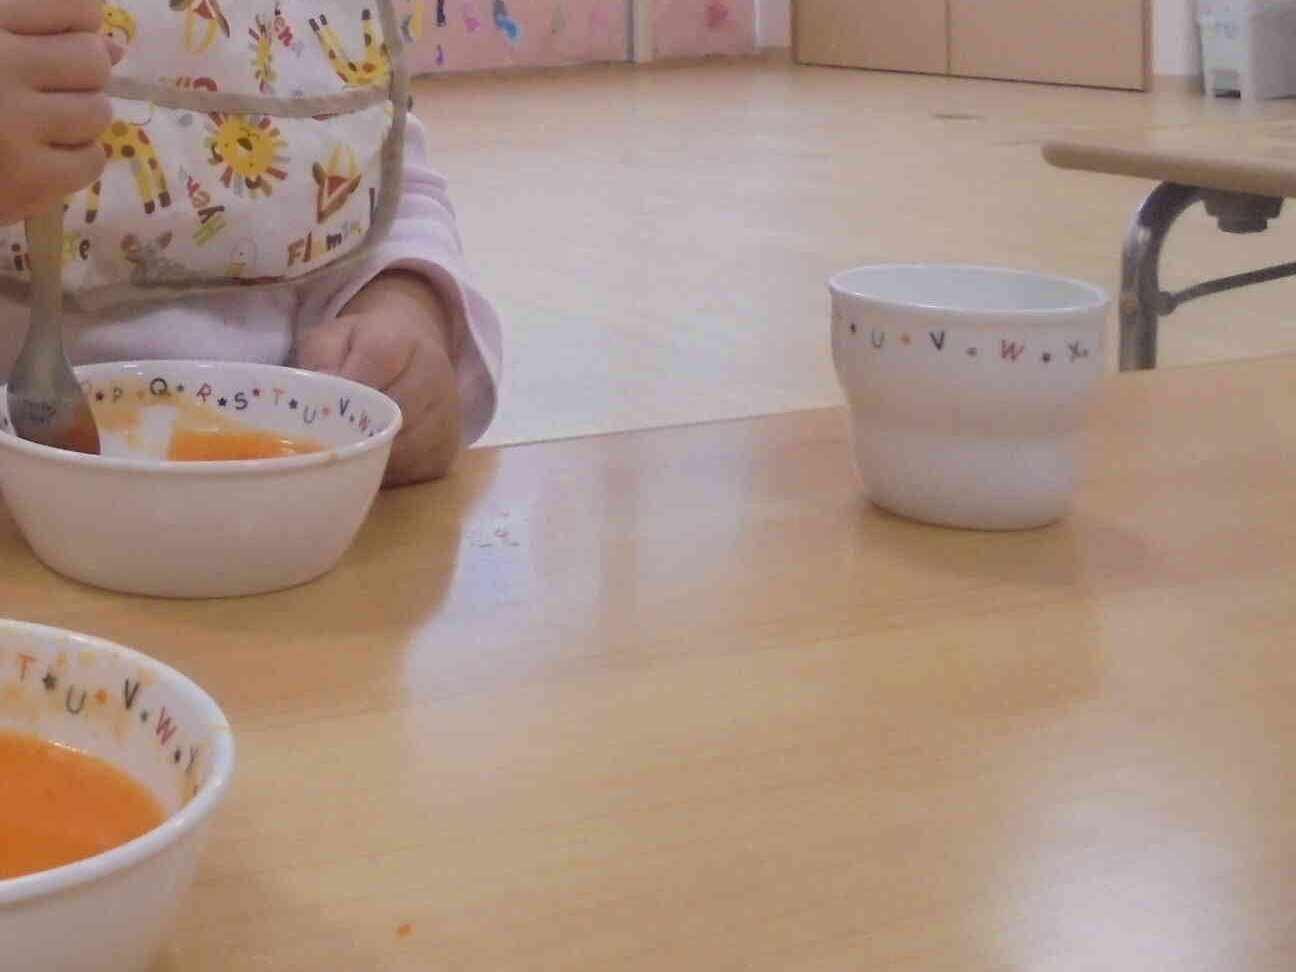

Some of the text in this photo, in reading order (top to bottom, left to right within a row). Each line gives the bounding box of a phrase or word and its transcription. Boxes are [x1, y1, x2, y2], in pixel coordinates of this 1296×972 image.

[929, 331, 946, 351] V
[1001, 339, 1024, 361] W
[150, 377, 171, 397] Q
[234, 392, 248, 410] S
[273, 388, 285, 406] T
[303, 406, 317, 424] U
[339, 397, 351, 416] V
[17, 653, 37, 680] T
[65, 686, 88, 715] U
[124, 678, 141, 710] V
[155, 705, 177, 746] W
